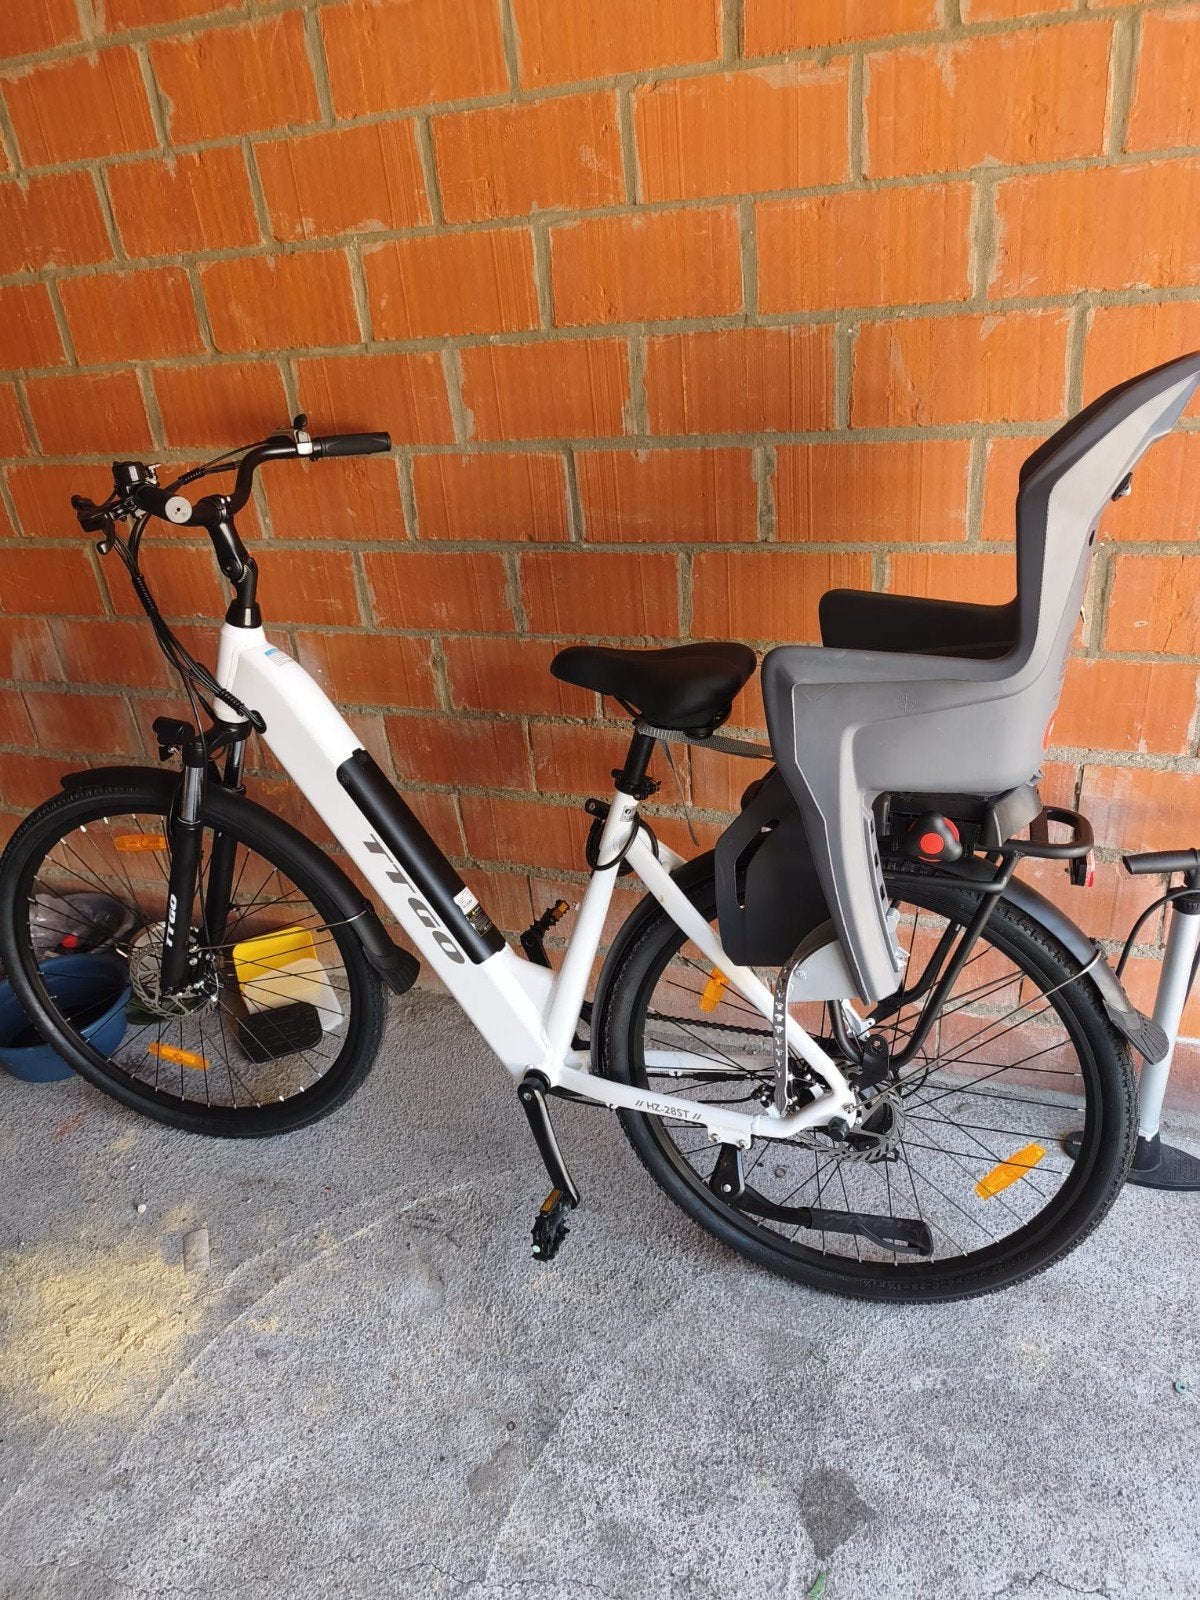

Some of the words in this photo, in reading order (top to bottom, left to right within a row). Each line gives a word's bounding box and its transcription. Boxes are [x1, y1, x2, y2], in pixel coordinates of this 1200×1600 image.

[165, 893, 178, 948] TTGO
[362, 833, 466, 965] TTGO
[646, 1101, 690, 1119] HZ-28ST
